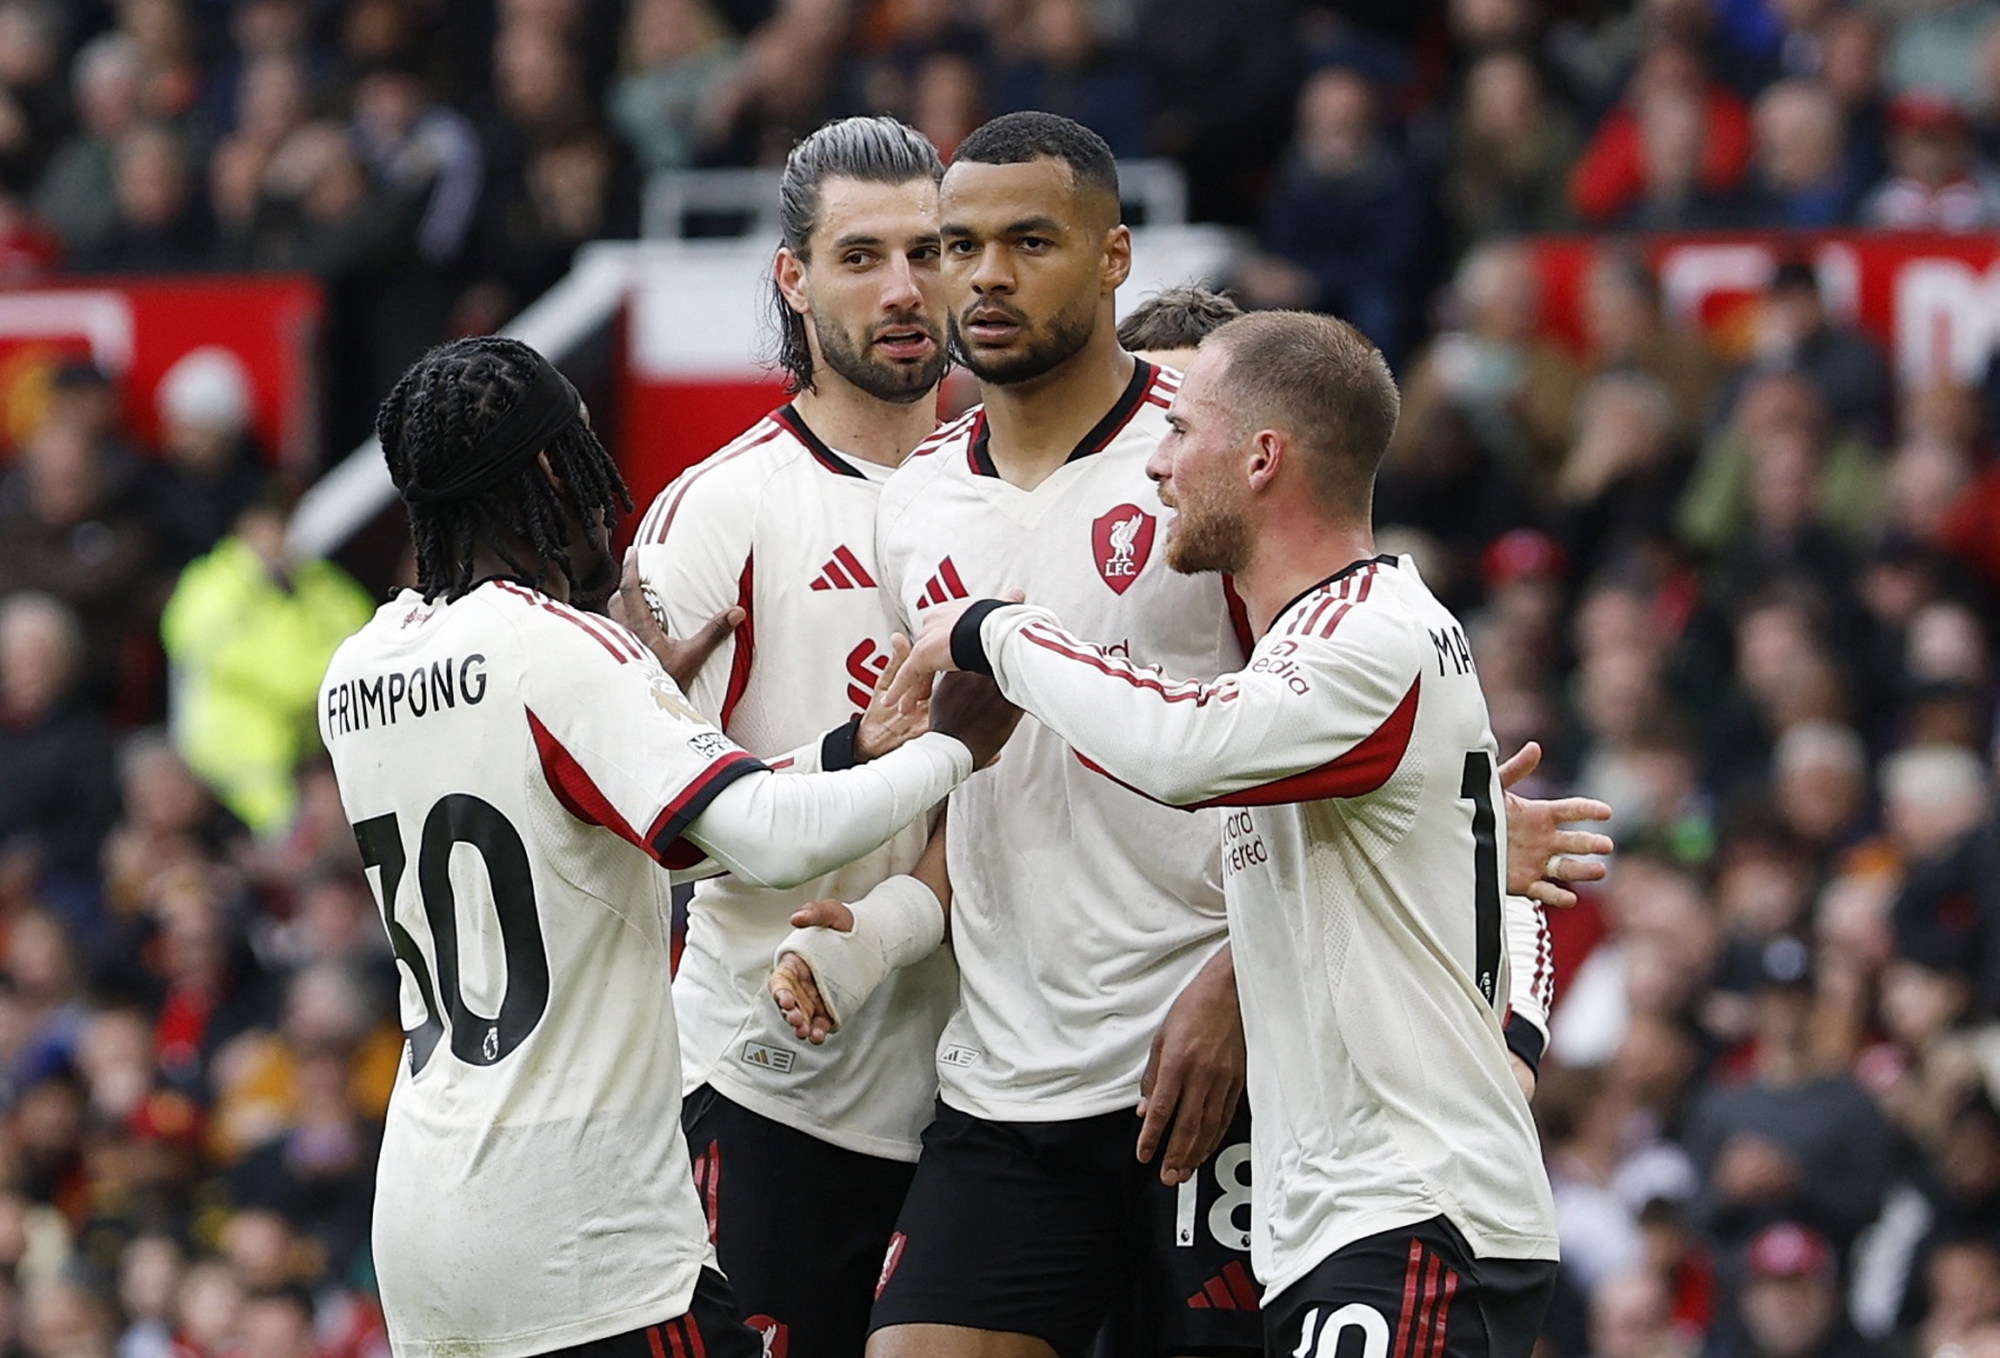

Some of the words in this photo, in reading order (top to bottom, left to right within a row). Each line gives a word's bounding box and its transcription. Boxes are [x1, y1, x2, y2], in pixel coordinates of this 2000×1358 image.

[1252, 657, 1310, 696] edia
[1427, 625, 1476, 677] MA
[328, 653, 487, 740] FRIMPONG
